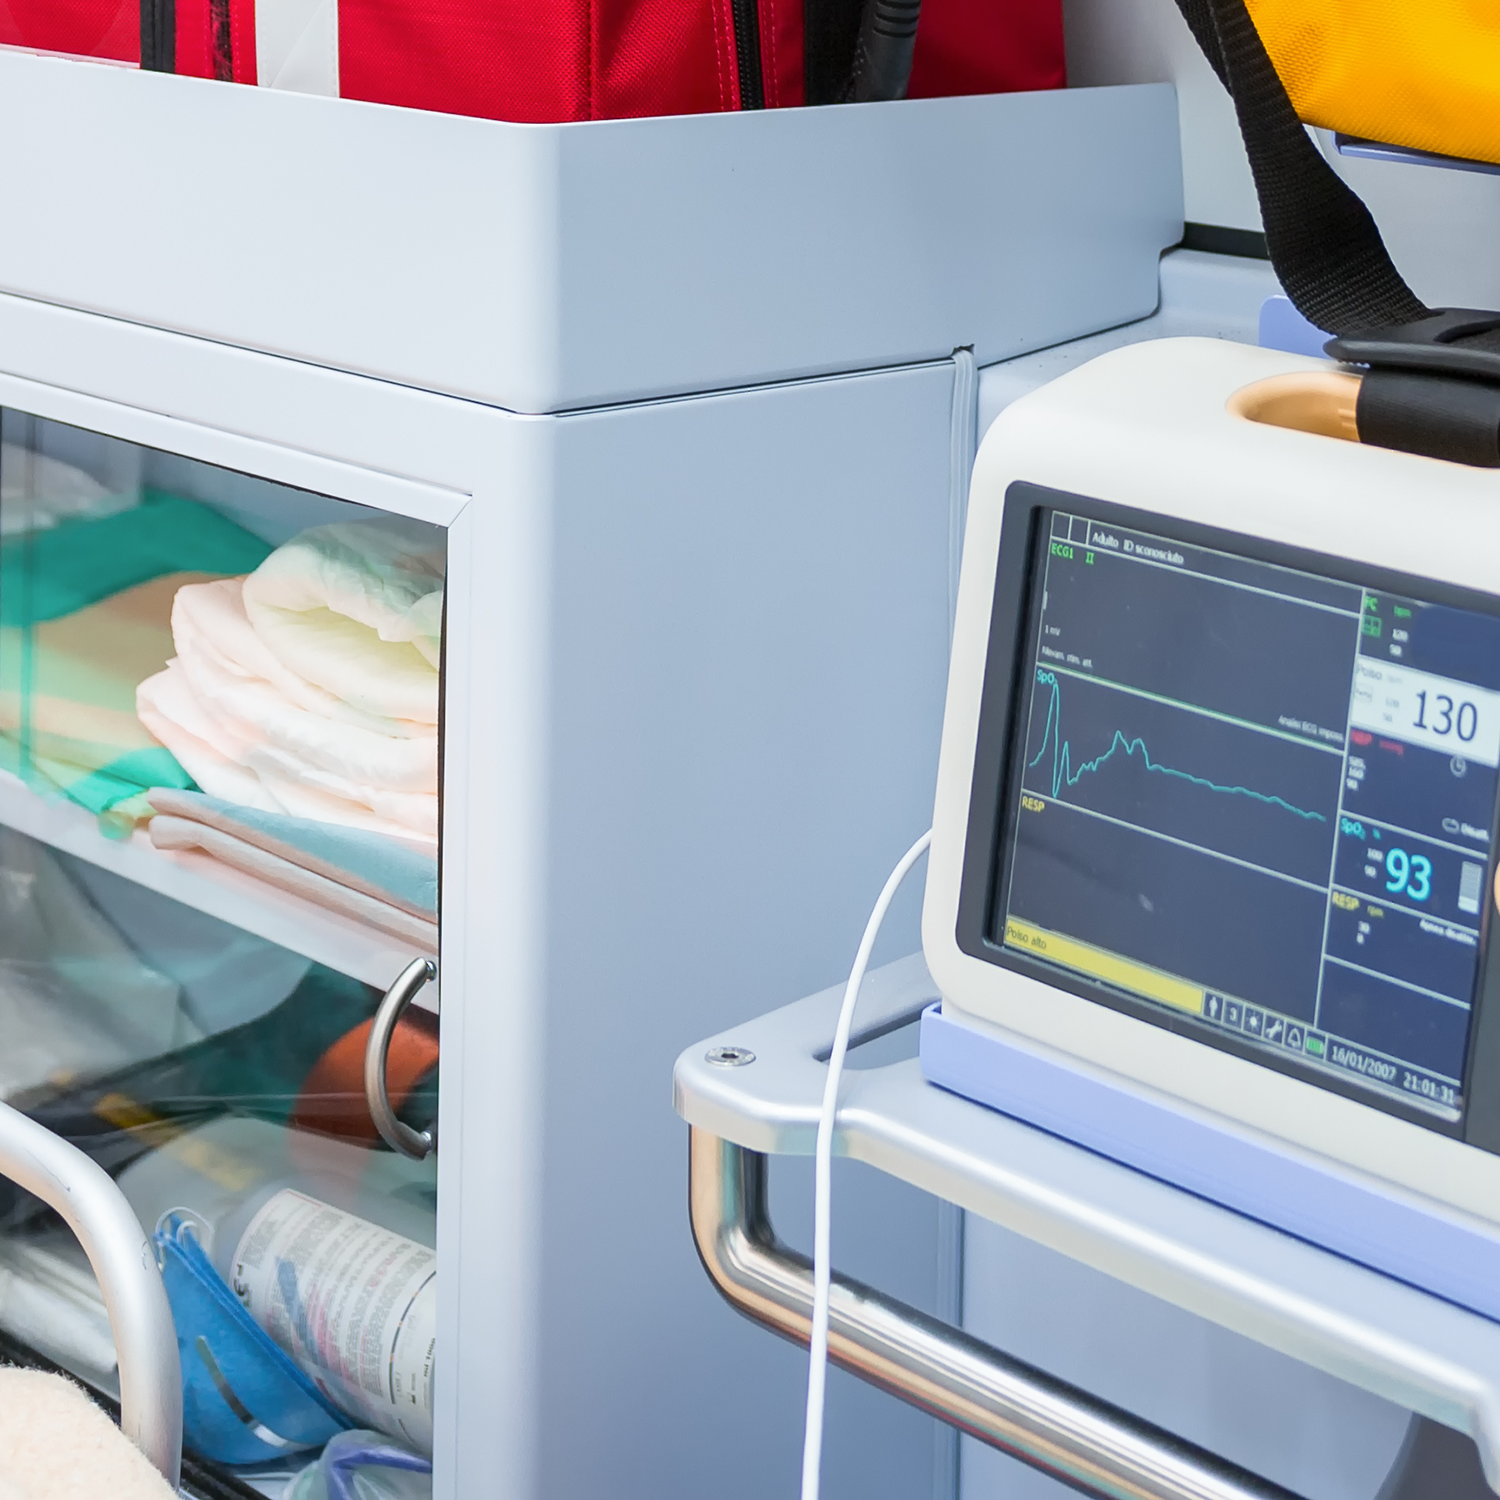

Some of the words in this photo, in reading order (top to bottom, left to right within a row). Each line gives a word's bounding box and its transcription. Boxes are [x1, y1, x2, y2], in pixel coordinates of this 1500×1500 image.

[1051, 543, 1074, 559] ECG1
[1092, 531, 1119, 548] Adulto
[1135, 544, 1184, 565] sconosciuto
[1416, 689, 1478, 742] 130
[1022, 796, 1045, 812] RESP
[1386, 848, 1432, 900] 93
[1007, 926, 1028, 943] Polso
[1031, 936, 1047, 949] alto
[1332, 1045, 1397, 1081] 16/01/2007
[1403, 1072, 1455, 1104] 21:01:31
